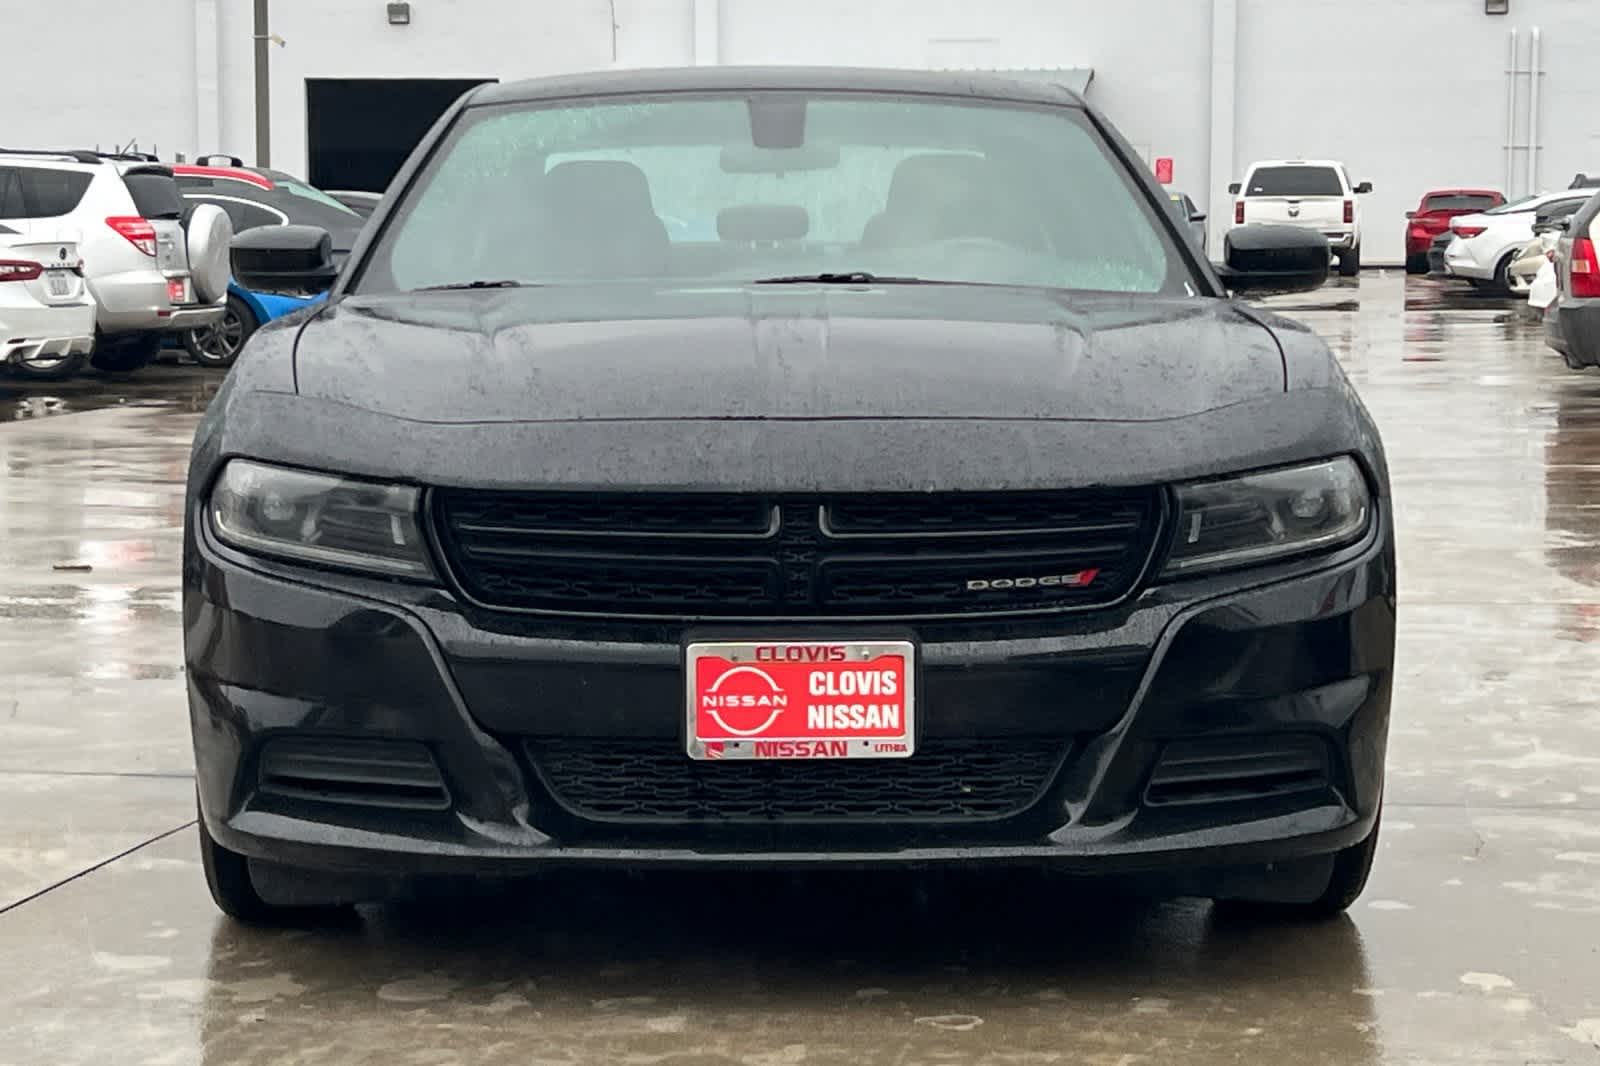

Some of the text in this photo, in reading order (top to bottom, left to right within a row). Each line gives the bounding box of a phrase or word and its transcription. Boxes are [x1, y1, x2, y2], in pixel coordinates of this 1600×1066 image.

[967, 575, 1081, 590] DODGE
[756, 646, 846, 661] CLOVIS
[809, 671, 897, 695] CLOVIS
[702, 695, 787, 707] NISSAN
[808, 704, 899, 729] NISSAN
[755, 741, 848, 756] NISSAN
